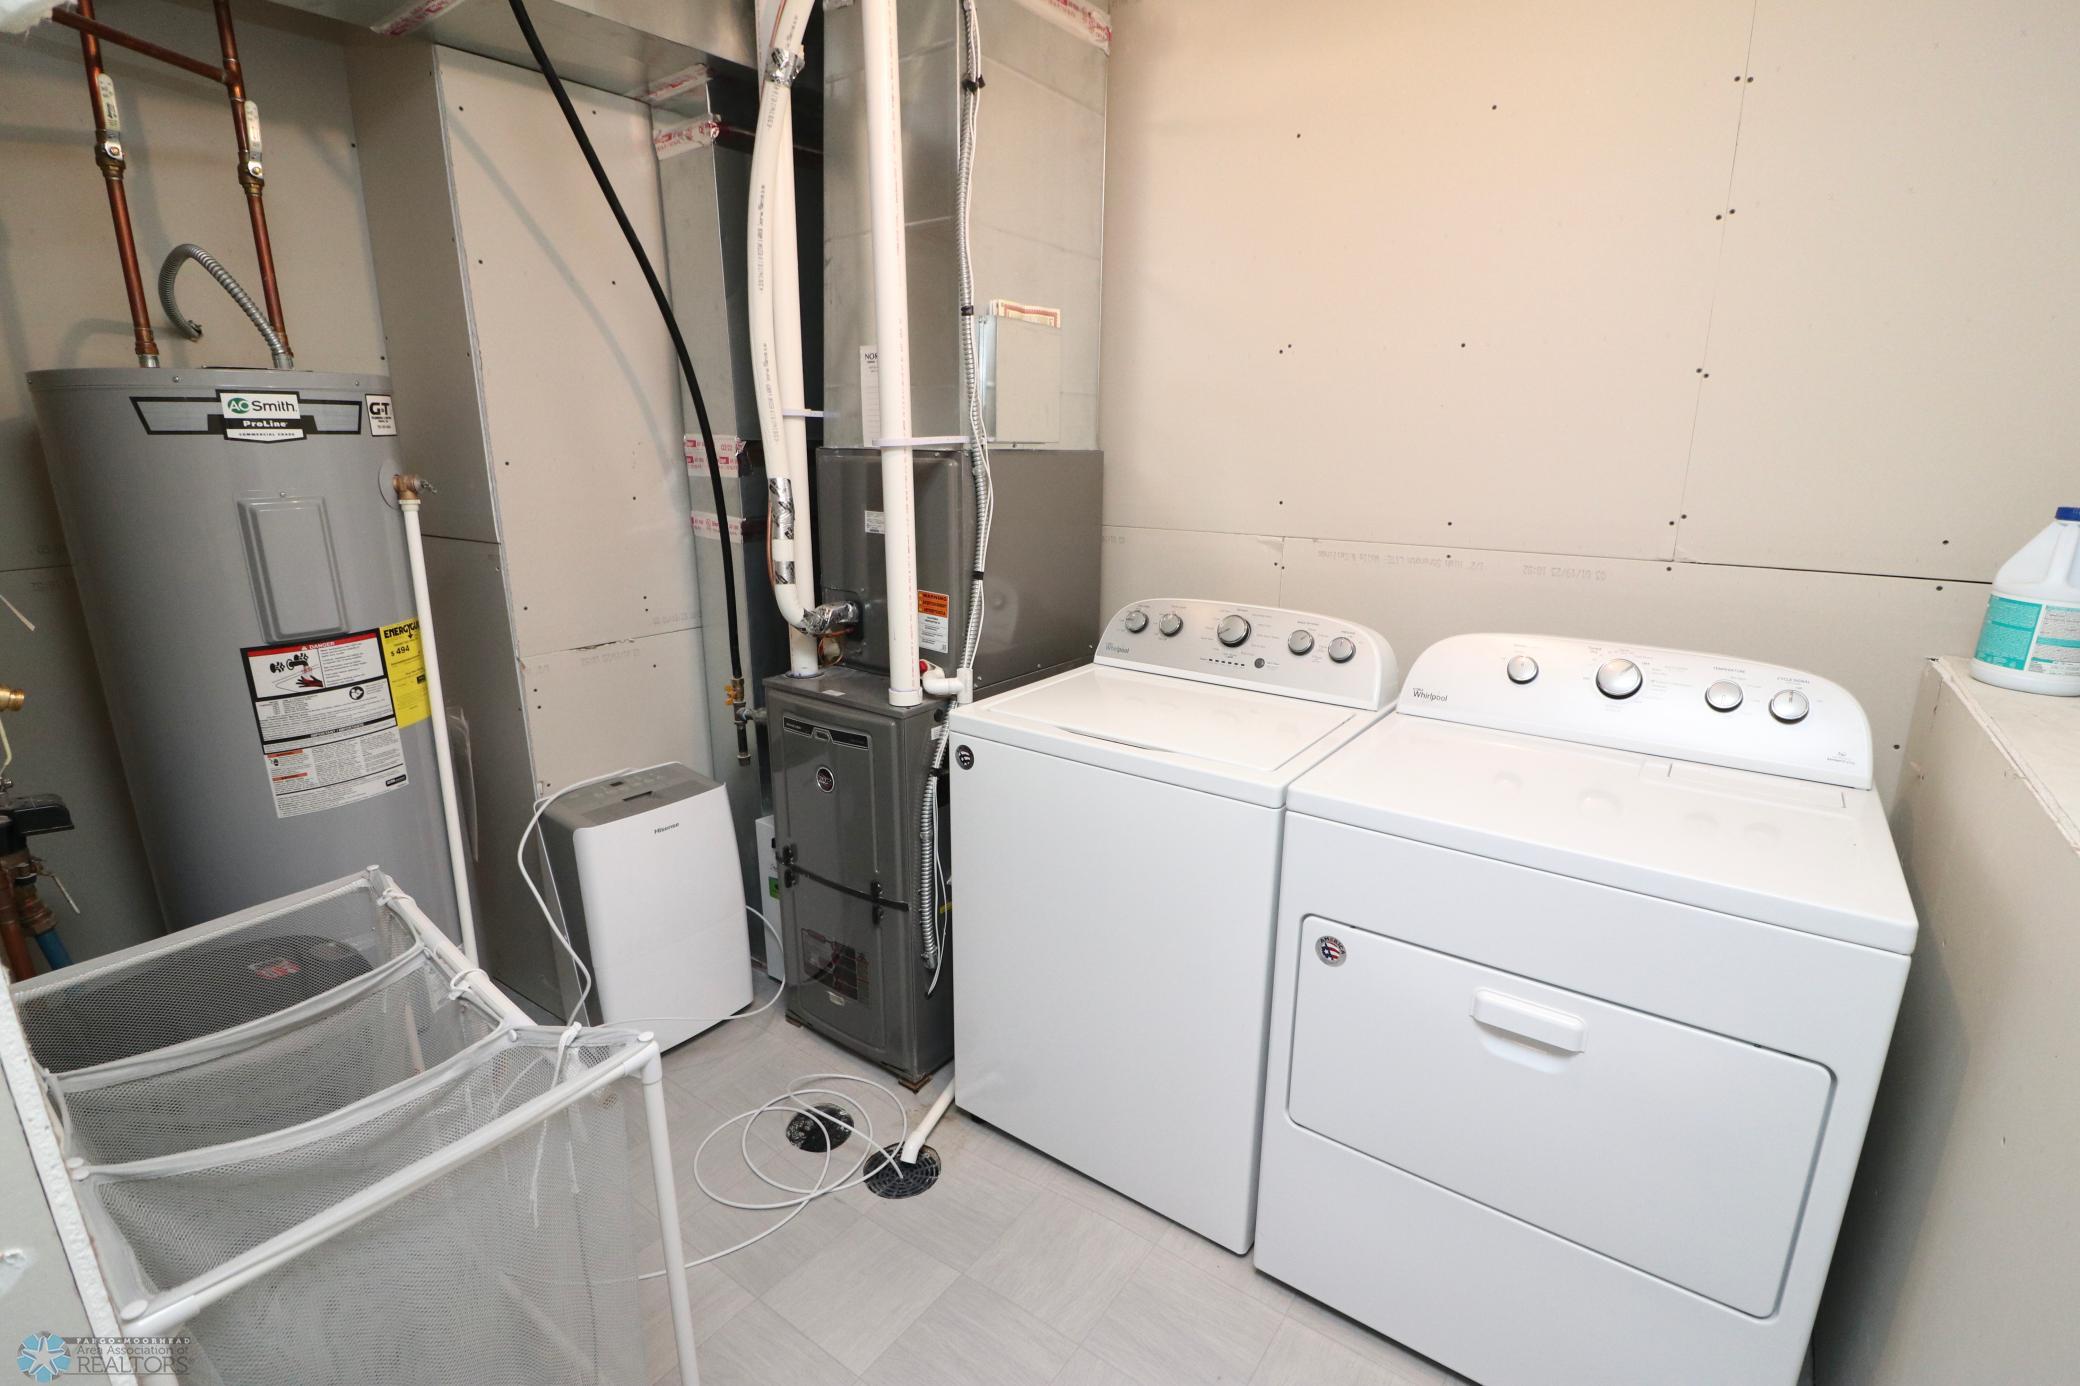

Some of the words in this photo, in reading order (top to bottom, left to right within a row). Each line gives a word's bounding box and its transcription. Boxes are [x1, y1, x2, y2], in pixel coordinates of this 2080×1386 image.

[251, 400, 296, 412] Smith
[309, 641, 336, 650] DANGER
[396, 645, 410, 654] 494
[1105, 643, 1130, 654] Whirlpool
[1413, 690, 1448, 702] Whirlpool
[654, 822, 680, 834] Hisense
